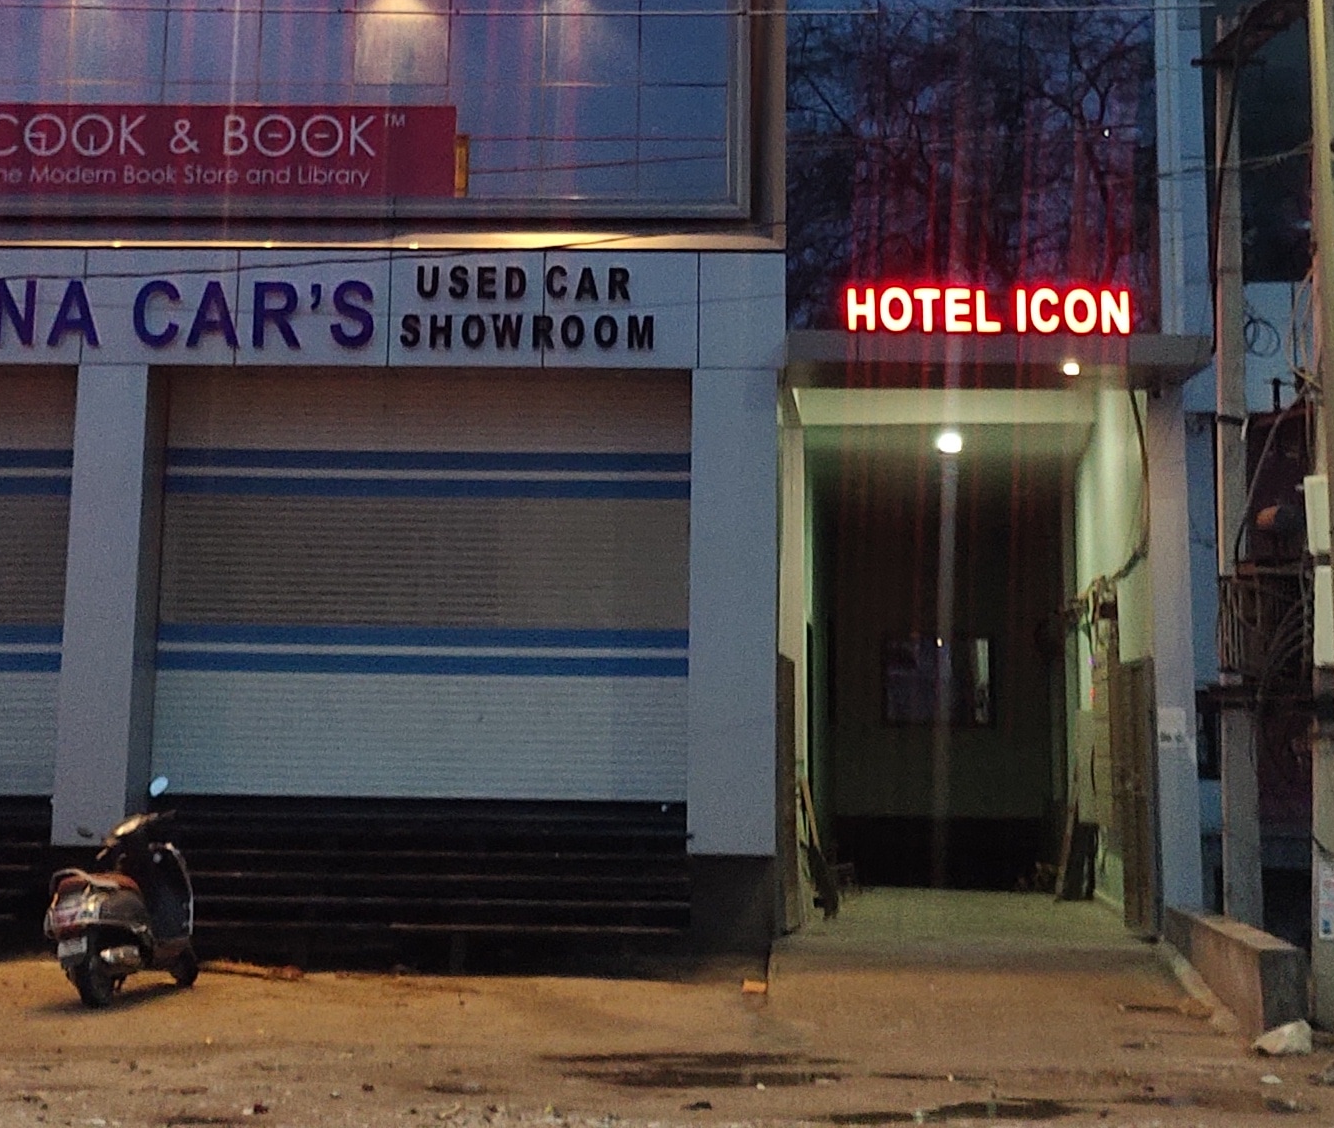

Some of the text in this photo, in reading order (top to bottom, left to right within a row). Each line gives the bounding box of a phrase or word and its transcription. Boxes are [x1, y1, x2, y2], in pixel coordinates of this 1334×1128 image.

[170, 119, 199, 154] &
[223, 114, 376, 157] BOOK
[29, 164, 116, 184] Modern
[123, 164, 176, 184] Book
[183, 164, 238, 185] Store
[247, 166, 290, 185] and
[298, 166, 370, 187] Library
[417, 265, 632, 302] USED CAR
[133, 280, 375, 349] CAR'S
[845, 286, 1132, 335] HOTEL ICON
[399, 314, 655, 350] SHOWROOM
